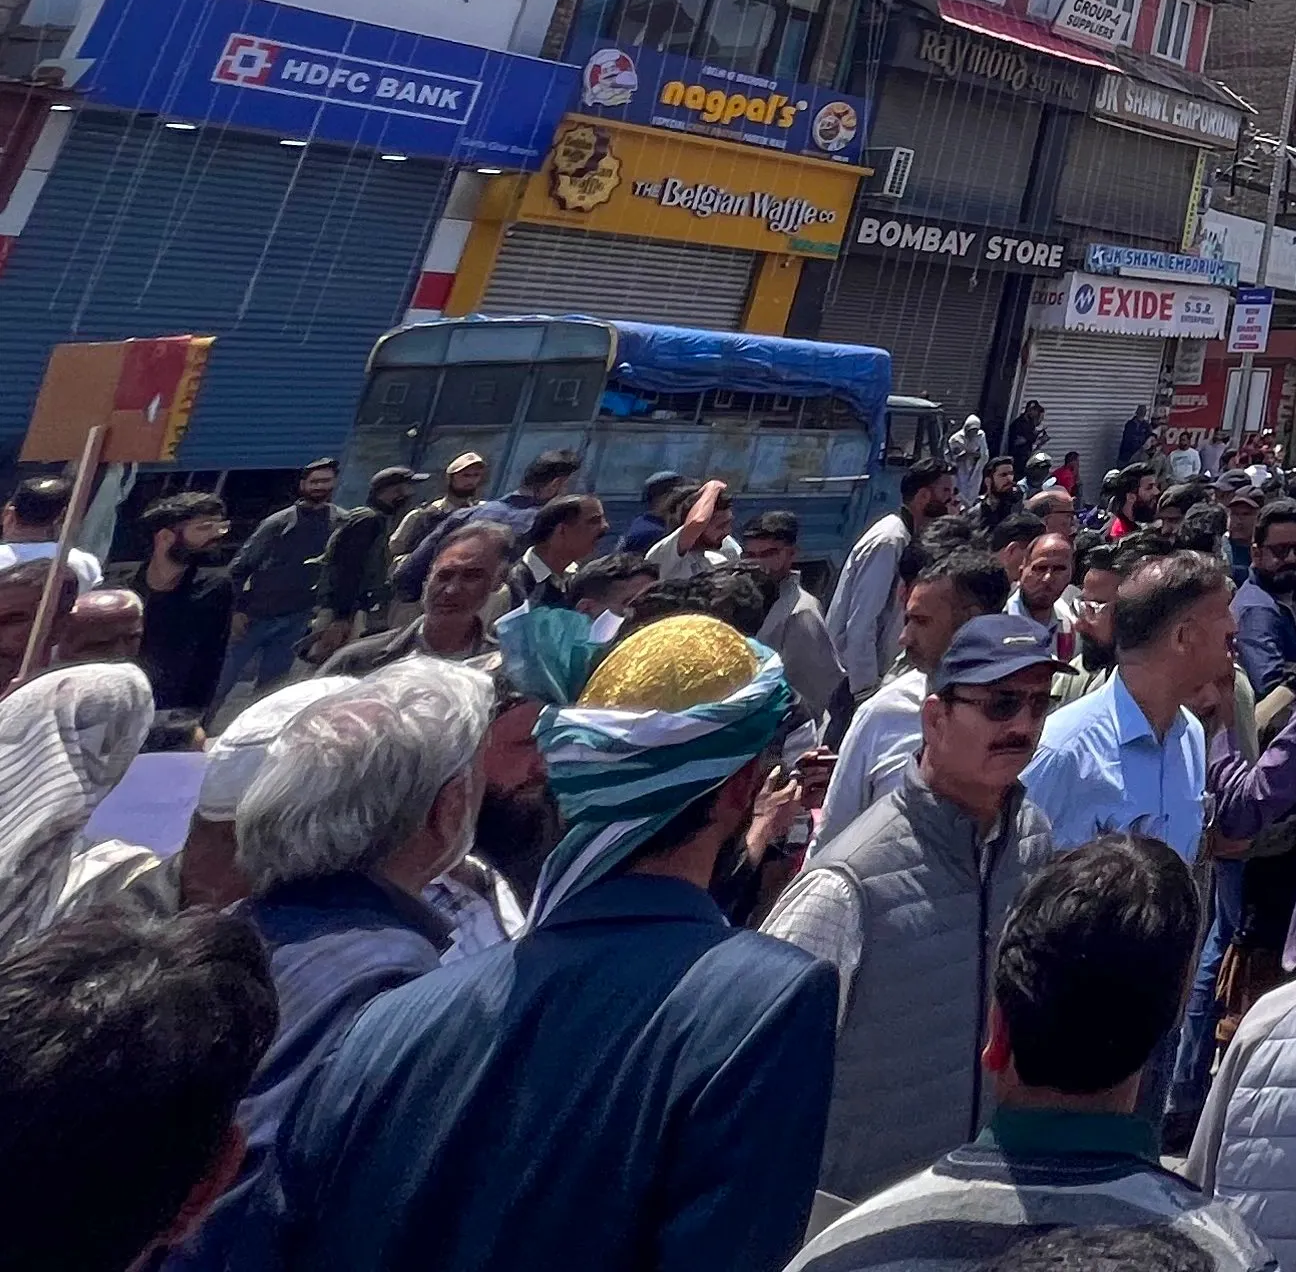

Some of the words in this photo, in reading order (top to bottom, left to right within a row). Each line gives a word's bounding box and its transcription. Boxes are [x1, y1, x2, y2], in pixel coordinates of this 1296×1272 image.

[1066, 13, 1115, 41] SUPPLIERS
[280, 58, 369, 94] HDFC
[375, 76, 463, 111] BANK
[920, 30, 1028, 91] Raymond
[660, 79, 799, 129] nagpal's
[1095, 72, 1119, 114] JK
[1124, 85, 1171, 123] SHAWL
[1173, 102, 1240, 143] EMPORIUM
[633, 181, 662, 198] THE
[661, 178, 749, 219] Belgian
[751, 192, 817, 234] Waffle
[857, 217, 976, 257] BOMBAY
[985, 235, 1064, 269] STORE
[1126, 251, 1165, 269] SHAWL
[1169, 258, 1226, 276] EMPORIUM
[1097, 286, 1176, 321] EXIDE
